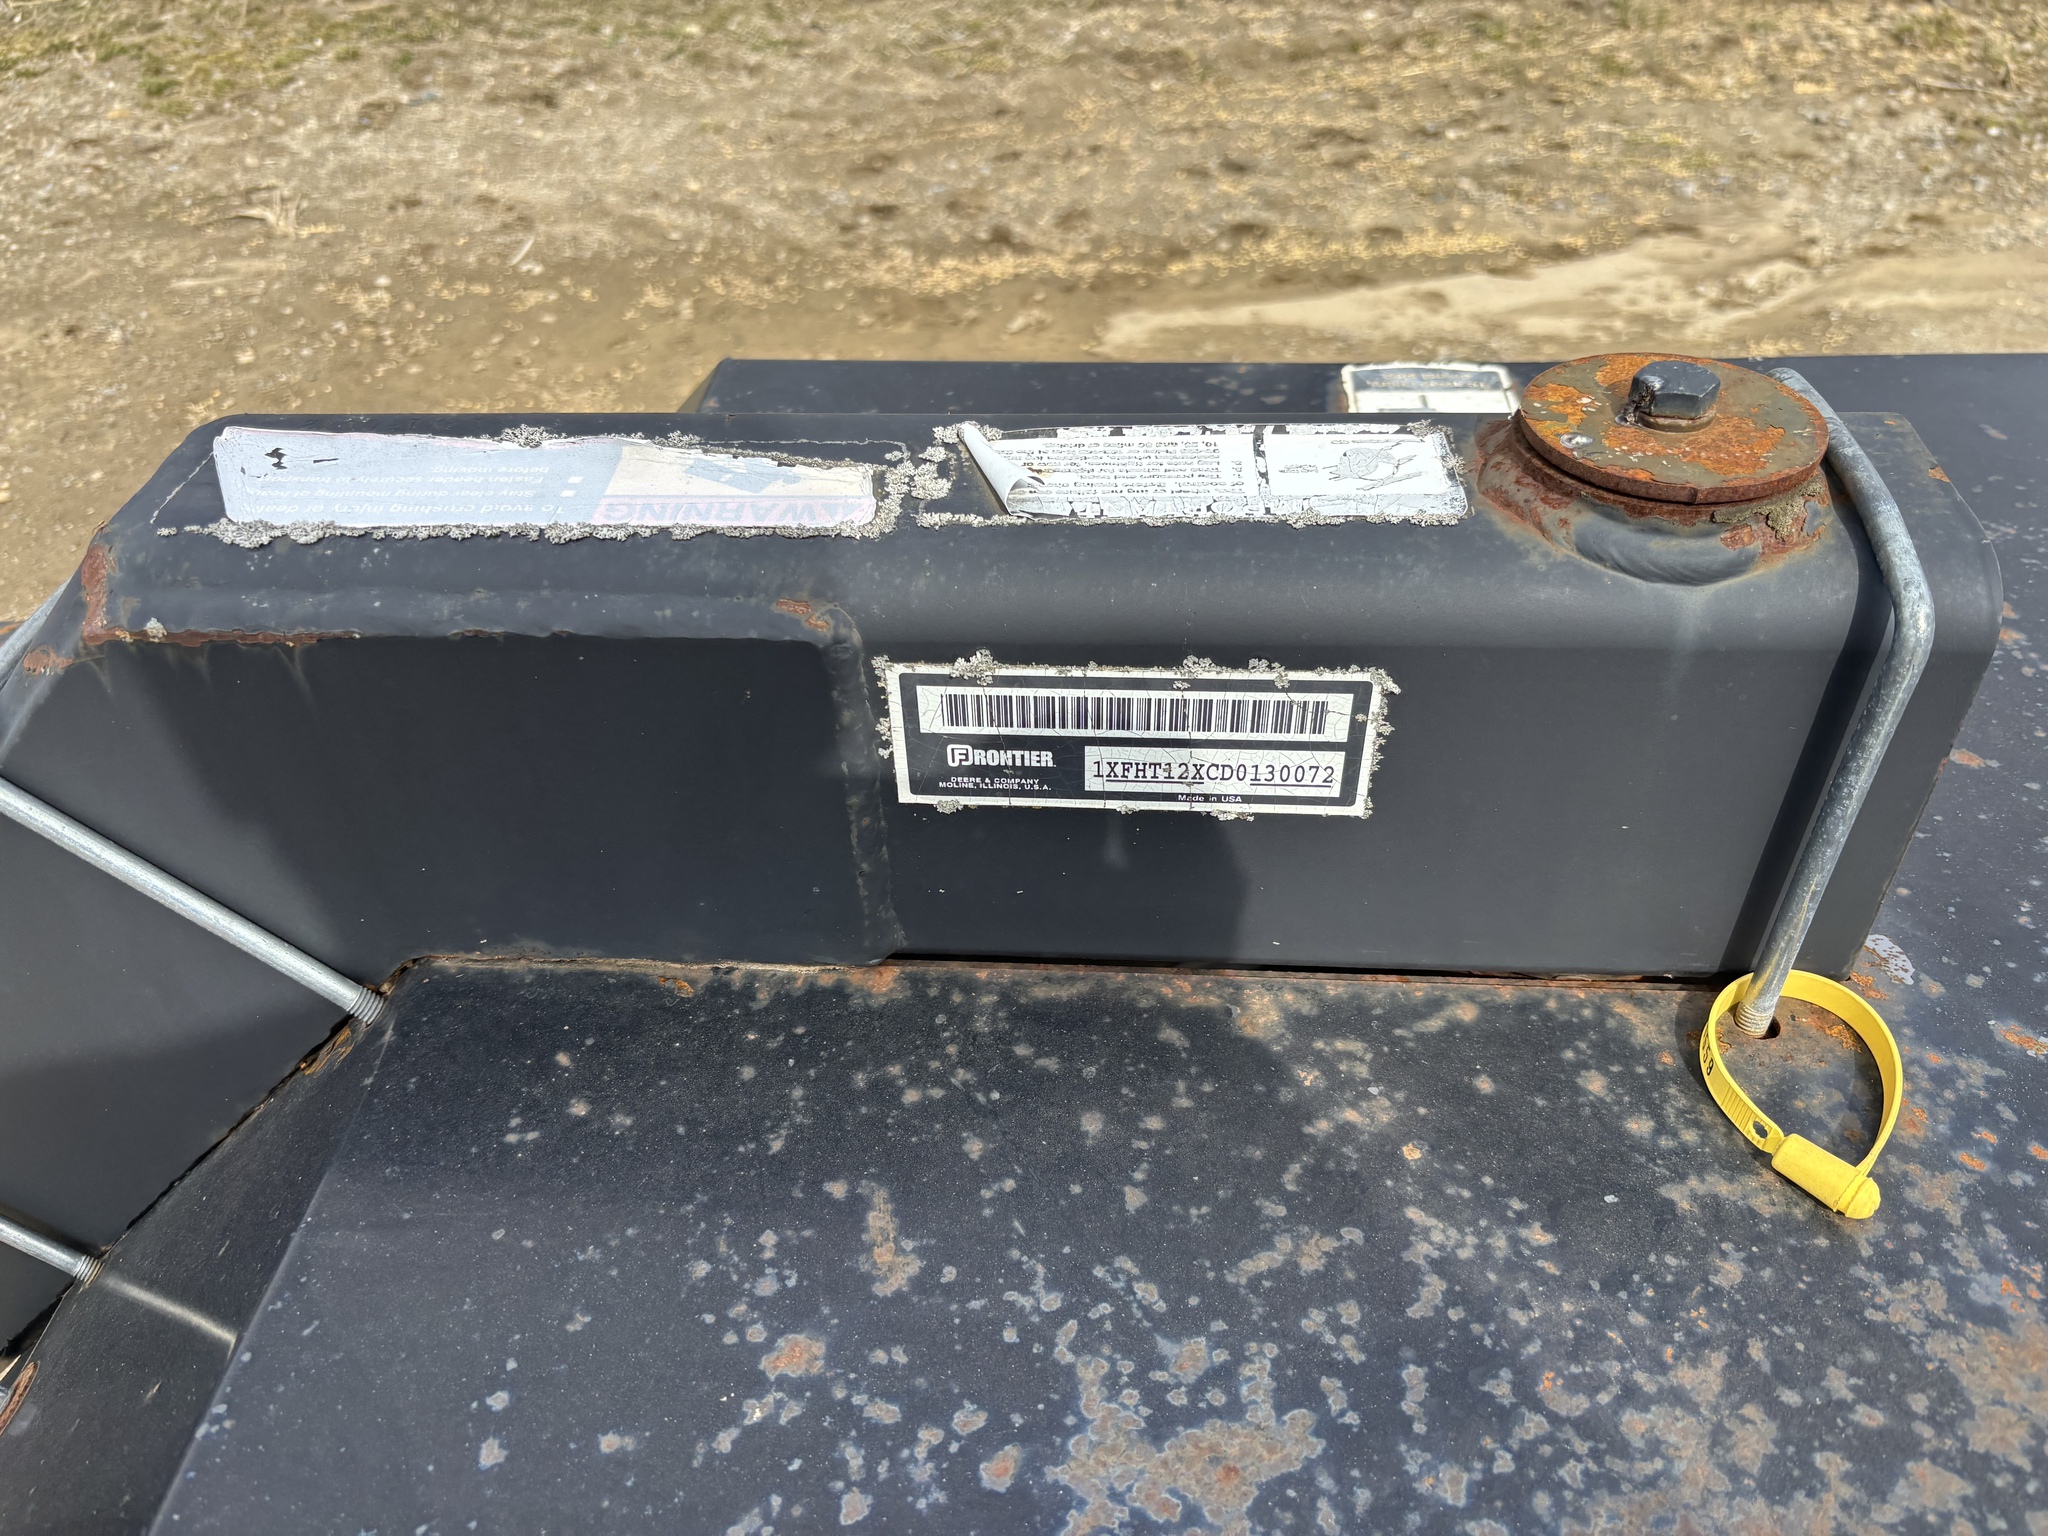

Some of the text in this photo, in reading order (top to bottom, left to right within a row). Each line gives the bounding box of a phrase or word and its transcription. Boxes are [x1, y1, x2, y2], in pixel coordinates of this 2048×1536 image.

[430, 465, 550, 474] before moving.
[336, 476, 351, 484] to
[354, 475, 424, 484] securely
[427, 476, 484, 484] header
[488, 476, 544, 484] Fasten
[315, 489, 391, 498] mounting
[393, 489, 448, 497] during
[498, 489, 536, 497] Stay
[303, 504, 324, 513] or
[328, 503, 385, 513] injury
[389, 503, 476, 514] crushing
[479, 504, 534, 514] avoid
[541, 504, 563, 514] To
[603, 502, 817, 523] WARNING
[1092, 761, 1335, 784] 1XFHT12XCD0130072
[939, 781, 977, 789] MOLINE,
